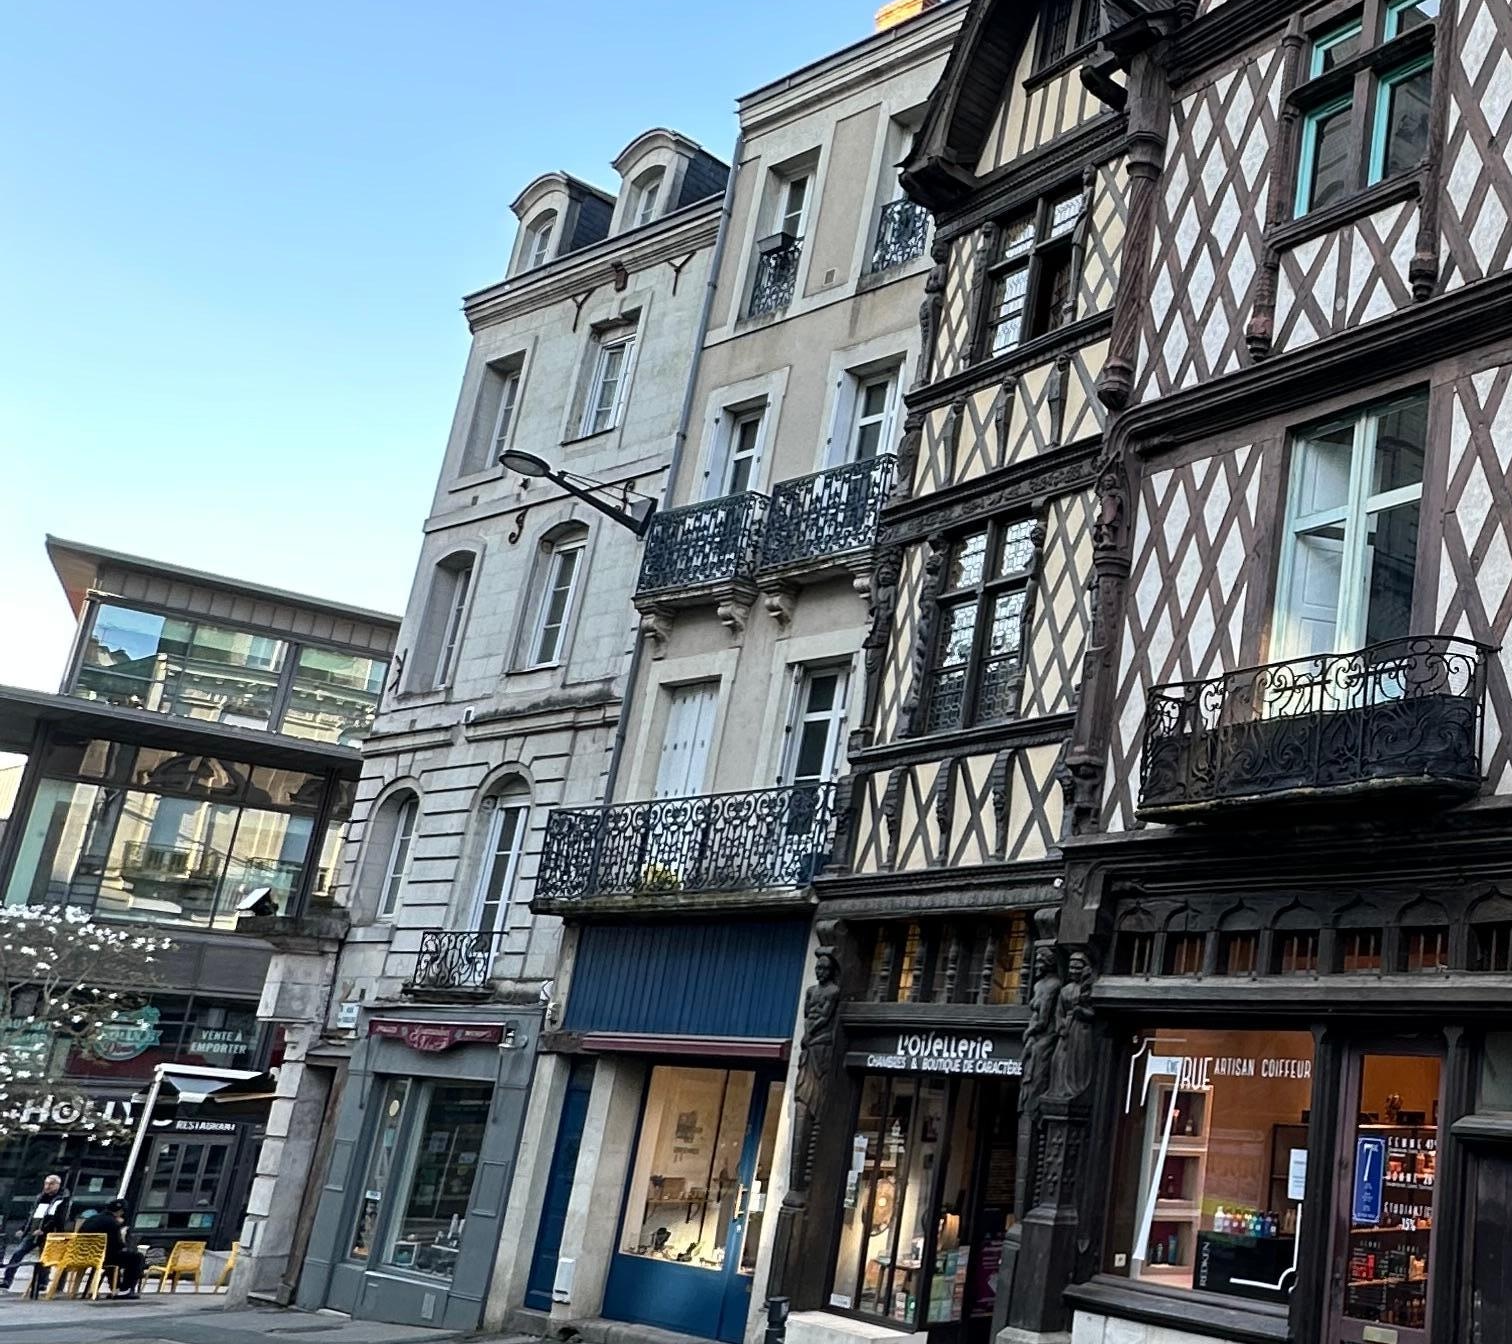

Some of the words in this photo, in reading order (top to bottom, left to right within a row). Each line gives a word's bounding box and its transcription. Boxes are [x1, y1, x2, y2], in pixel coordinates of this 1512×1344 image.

[201, 1030, 232, 1041] VENTE
[190, 1042, 248, 1054] EMPORTER
[867, 1055, 907, 1069] CHAMBRES
[910, 1058, 918, 1069] &
[922, 1058, 960, 1073] BOUTIQUE
[963, 1060, 974, 1073] DE
[1181, 1057, 1214, 1090] RUE
[1214, 1057, 1254, 1077] ARTISAN
[1262, 1059, 1311, 1078] COIFFEUR
[1200, 1242, 1210, 1286] REDKEN
